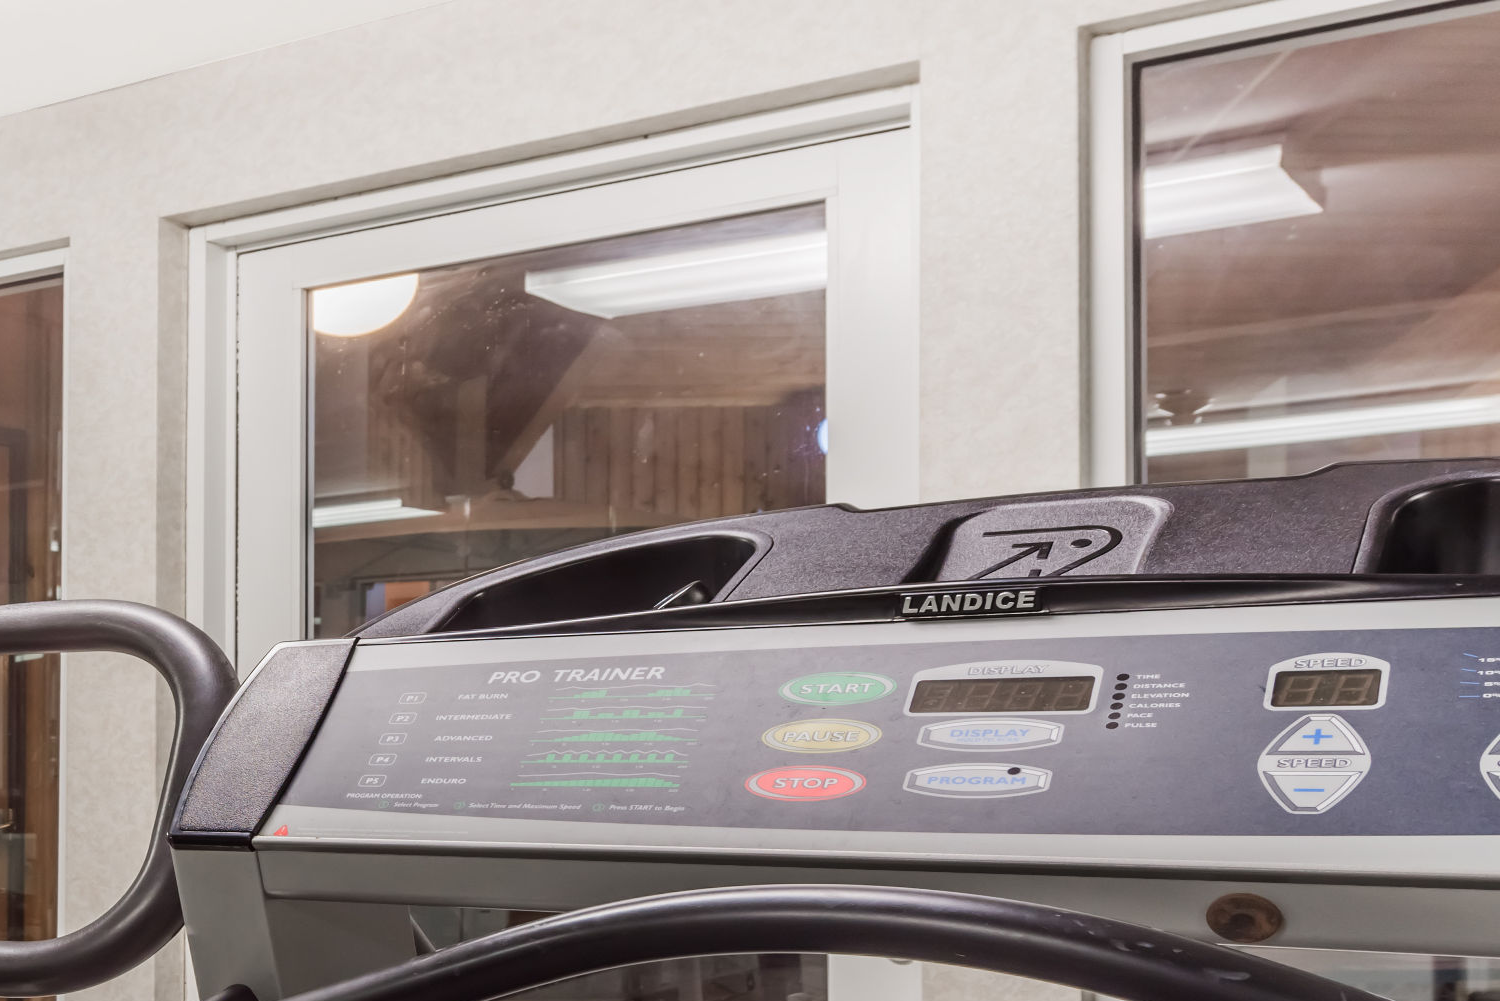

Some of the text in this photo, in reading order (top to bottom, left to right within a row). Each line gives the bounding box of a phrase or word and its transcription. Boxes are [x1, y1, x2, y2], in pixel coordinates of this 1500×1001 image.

[902, 590, 1036, 614] LANDICE
[1294, 658, 1368, 669] SPEED
[487, 666, 666, 685] PRO TRAINER
[968, 664, 1050, 676] DISPLAY
[800, 682, 876, 695] START
[436, 713, 514, 721] INTERMEDIATE
[781, 730, 861, 743] PAUSE
[950, 728, 1030, 738] DISPLAY
[1277, 758, 1352, 769] SPEED
[773, 777, 839, 789] STOP
[927, 775, 1027, 785] PROGRAM
[558, 803, 582, 811] Speed
